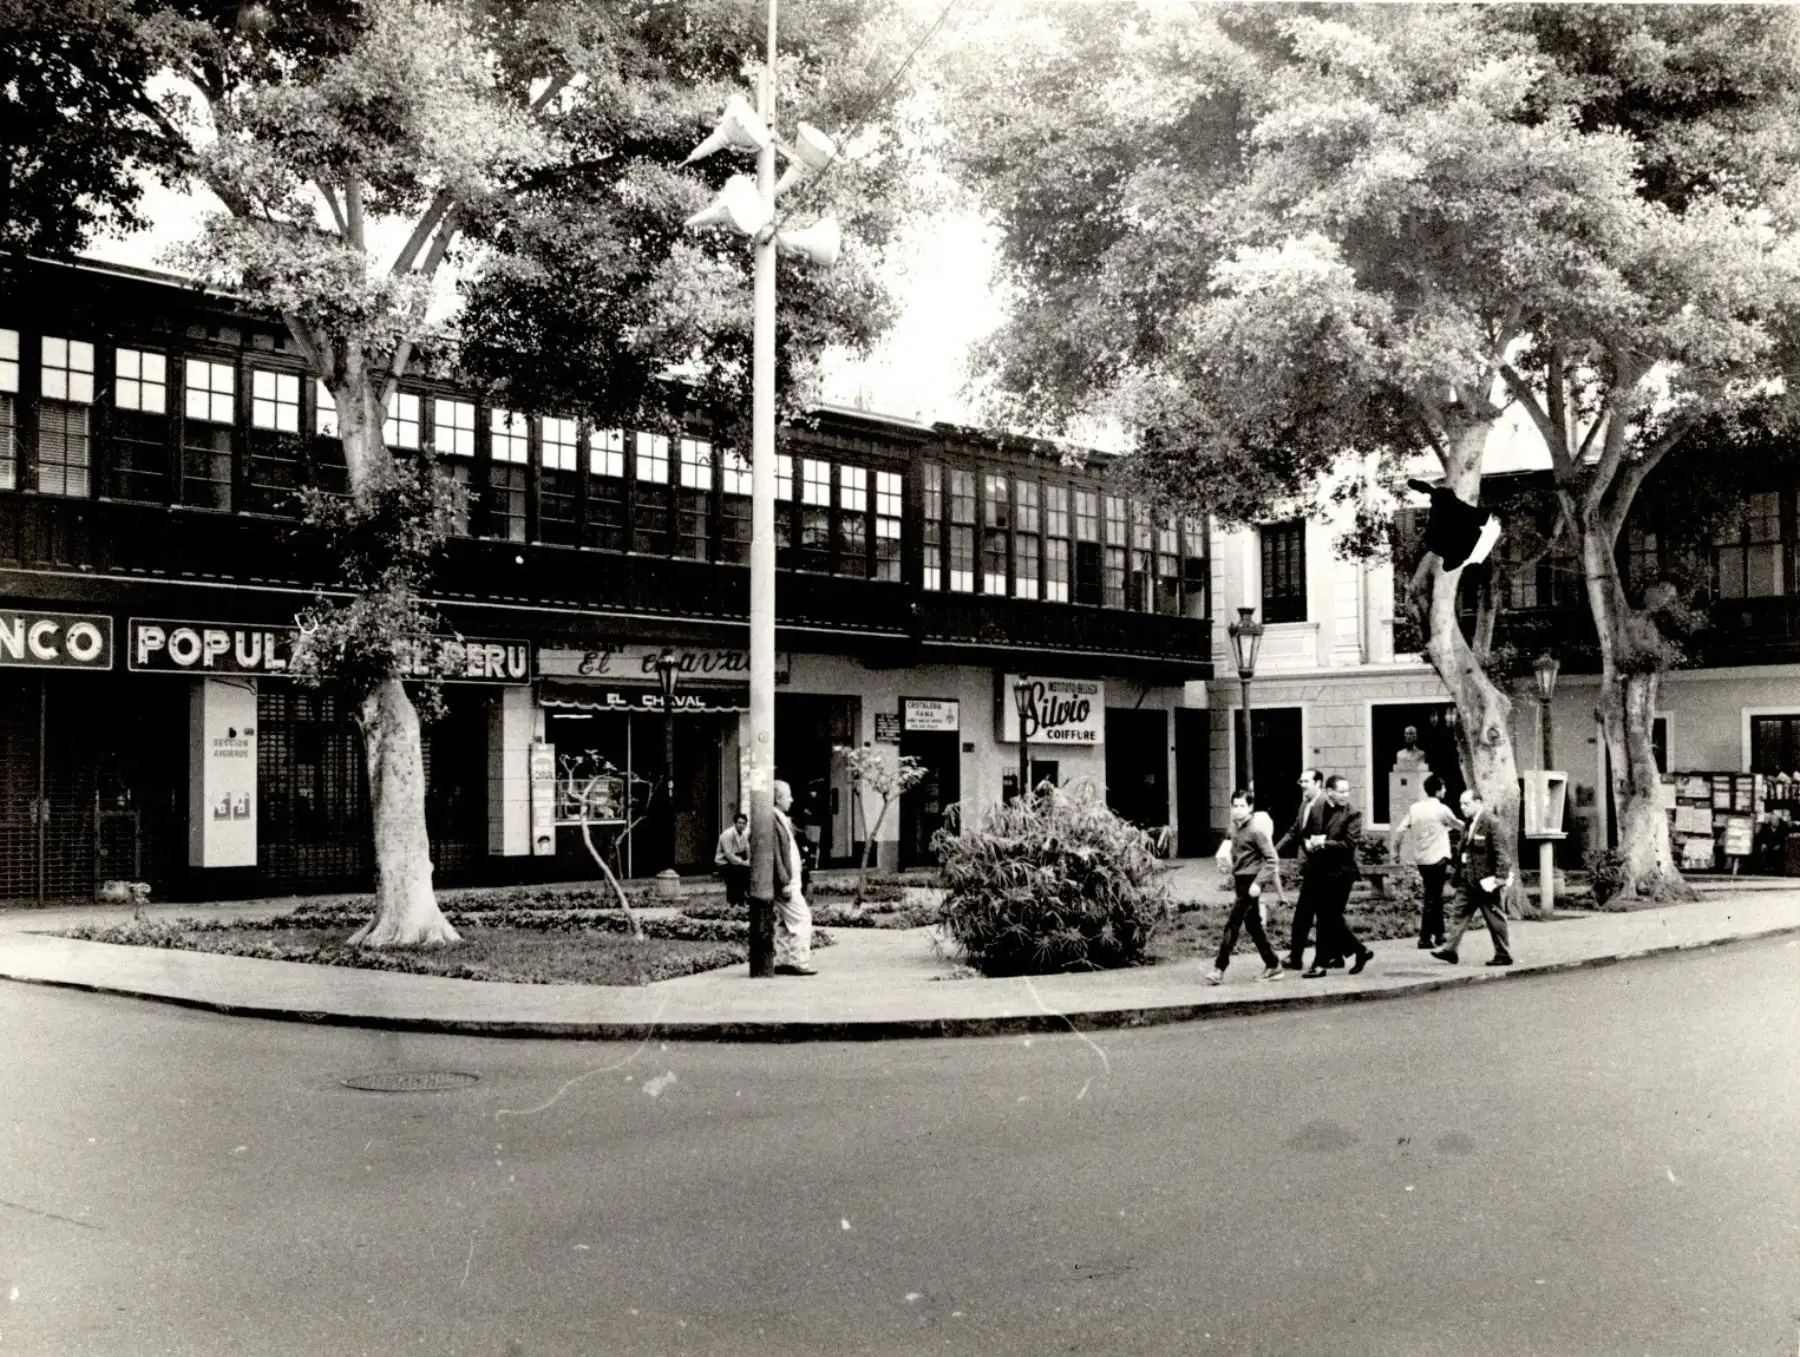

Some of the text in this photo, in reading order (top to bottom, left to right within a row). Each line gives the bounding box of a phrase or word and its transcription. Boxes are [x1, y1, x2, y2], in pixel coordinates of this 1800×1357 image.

[137, 626, 342, 671] POPULA
[444, 641, 526, 678] PERU
[579, 651, 611, 675] El
[607, 693, 706, 707] EL CHVAL
[1024, 681, 1091, 738] Silvio
[1047, 729, 1096, 741] COIFFURE
